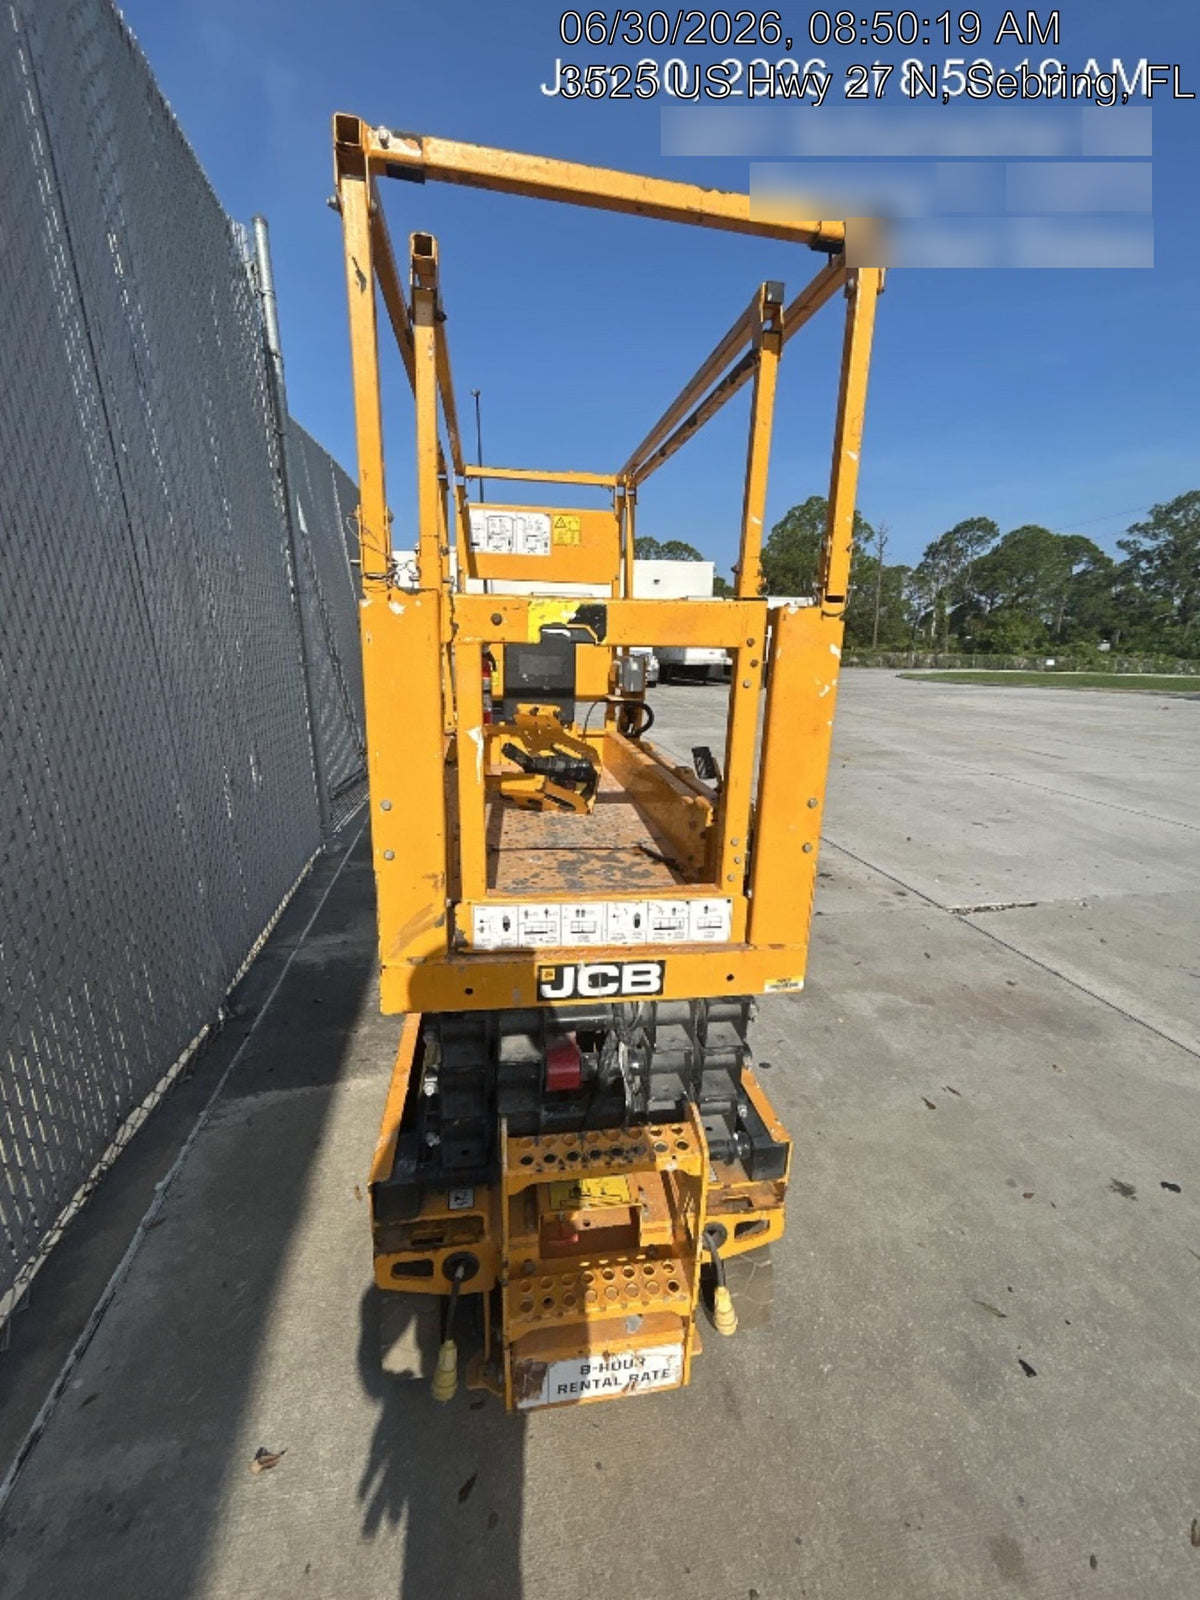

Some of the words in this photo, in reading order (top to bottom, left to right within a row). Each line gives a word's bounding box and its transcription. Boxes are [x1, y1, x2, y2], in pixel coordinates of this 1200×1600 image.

[540, 963, 661, 998] JCB
[557, 1376, 622, 1395] RENTAL
[628, 1368, 670, 1384] RATE
